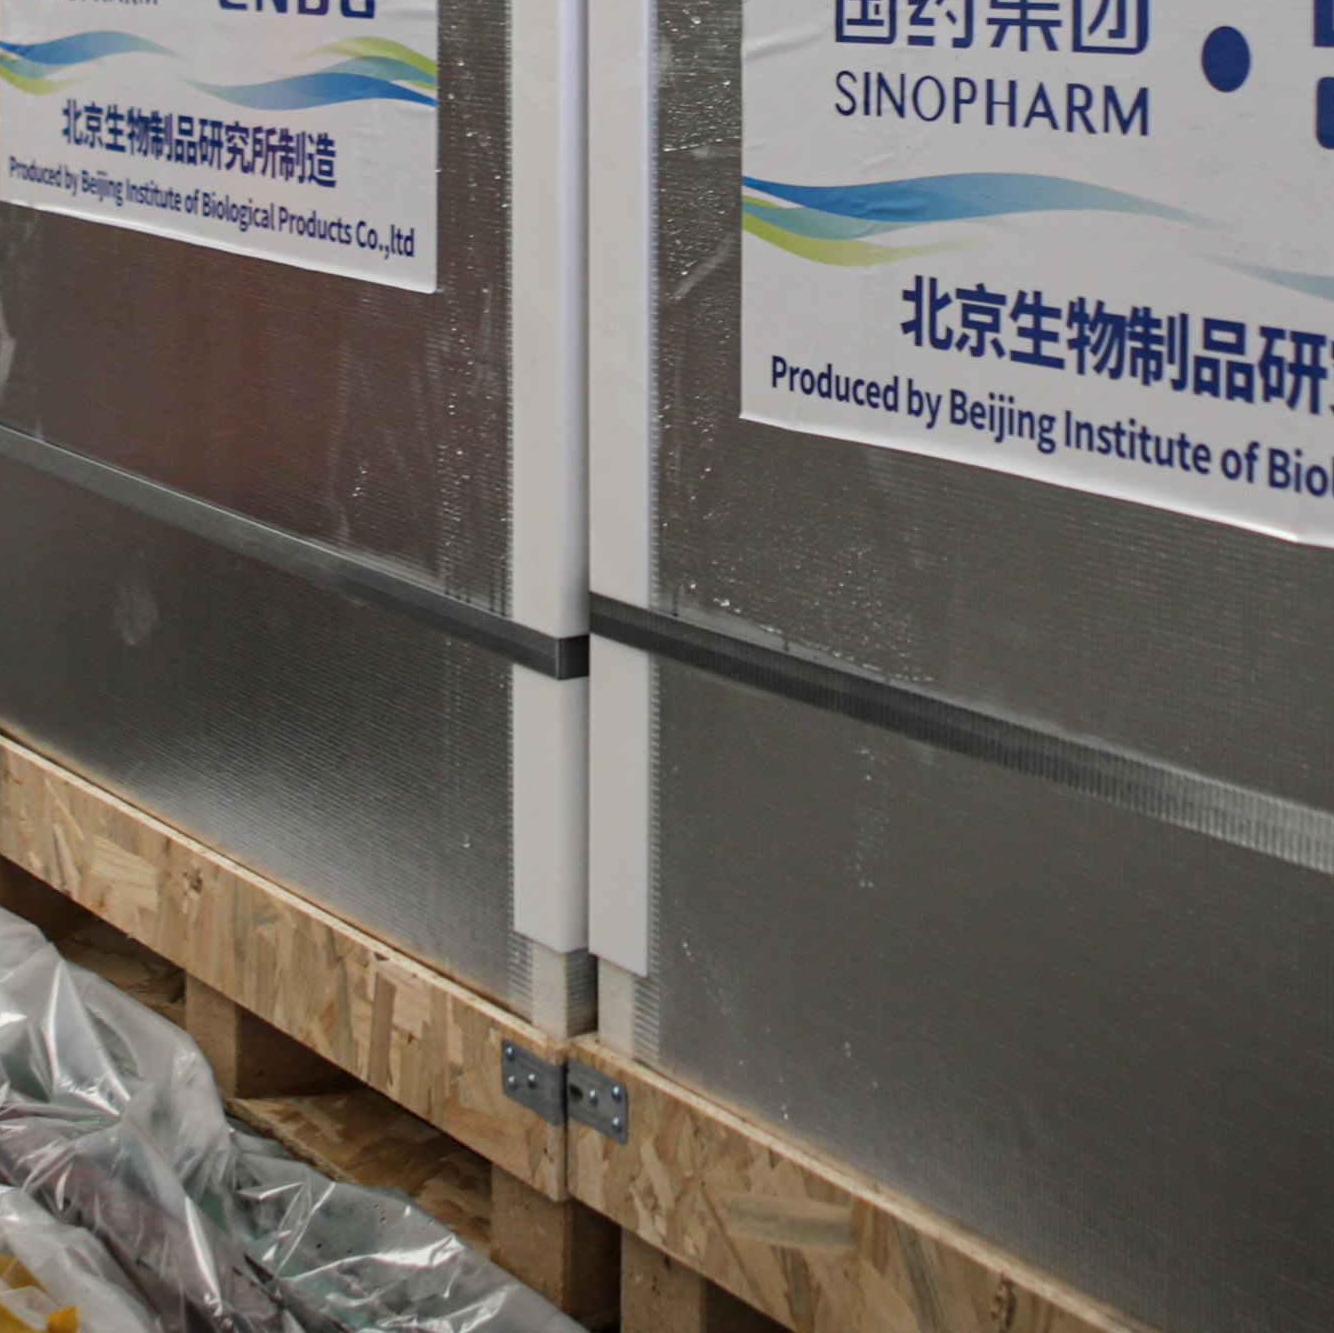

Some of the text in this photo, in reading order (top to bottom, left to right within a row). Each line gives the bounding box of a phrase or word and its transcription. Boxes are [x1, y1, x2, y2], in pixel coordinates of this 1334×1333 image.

[62, 99, 338, 189] 北京生物制品研究所制造
[834, 68, 1150, 137] SINOPHARM
[9, 154, 416, 260] Produced by Beijing Institute of Biological Products Co.,ltd
[770, 354, 900, 415] Produced
[906, 378, 943, 430] by
[949, 387, 1057, 455] Beijing
[1065, 409, 1213, 476] Institute
[1220, 439, 1261, 484] of
